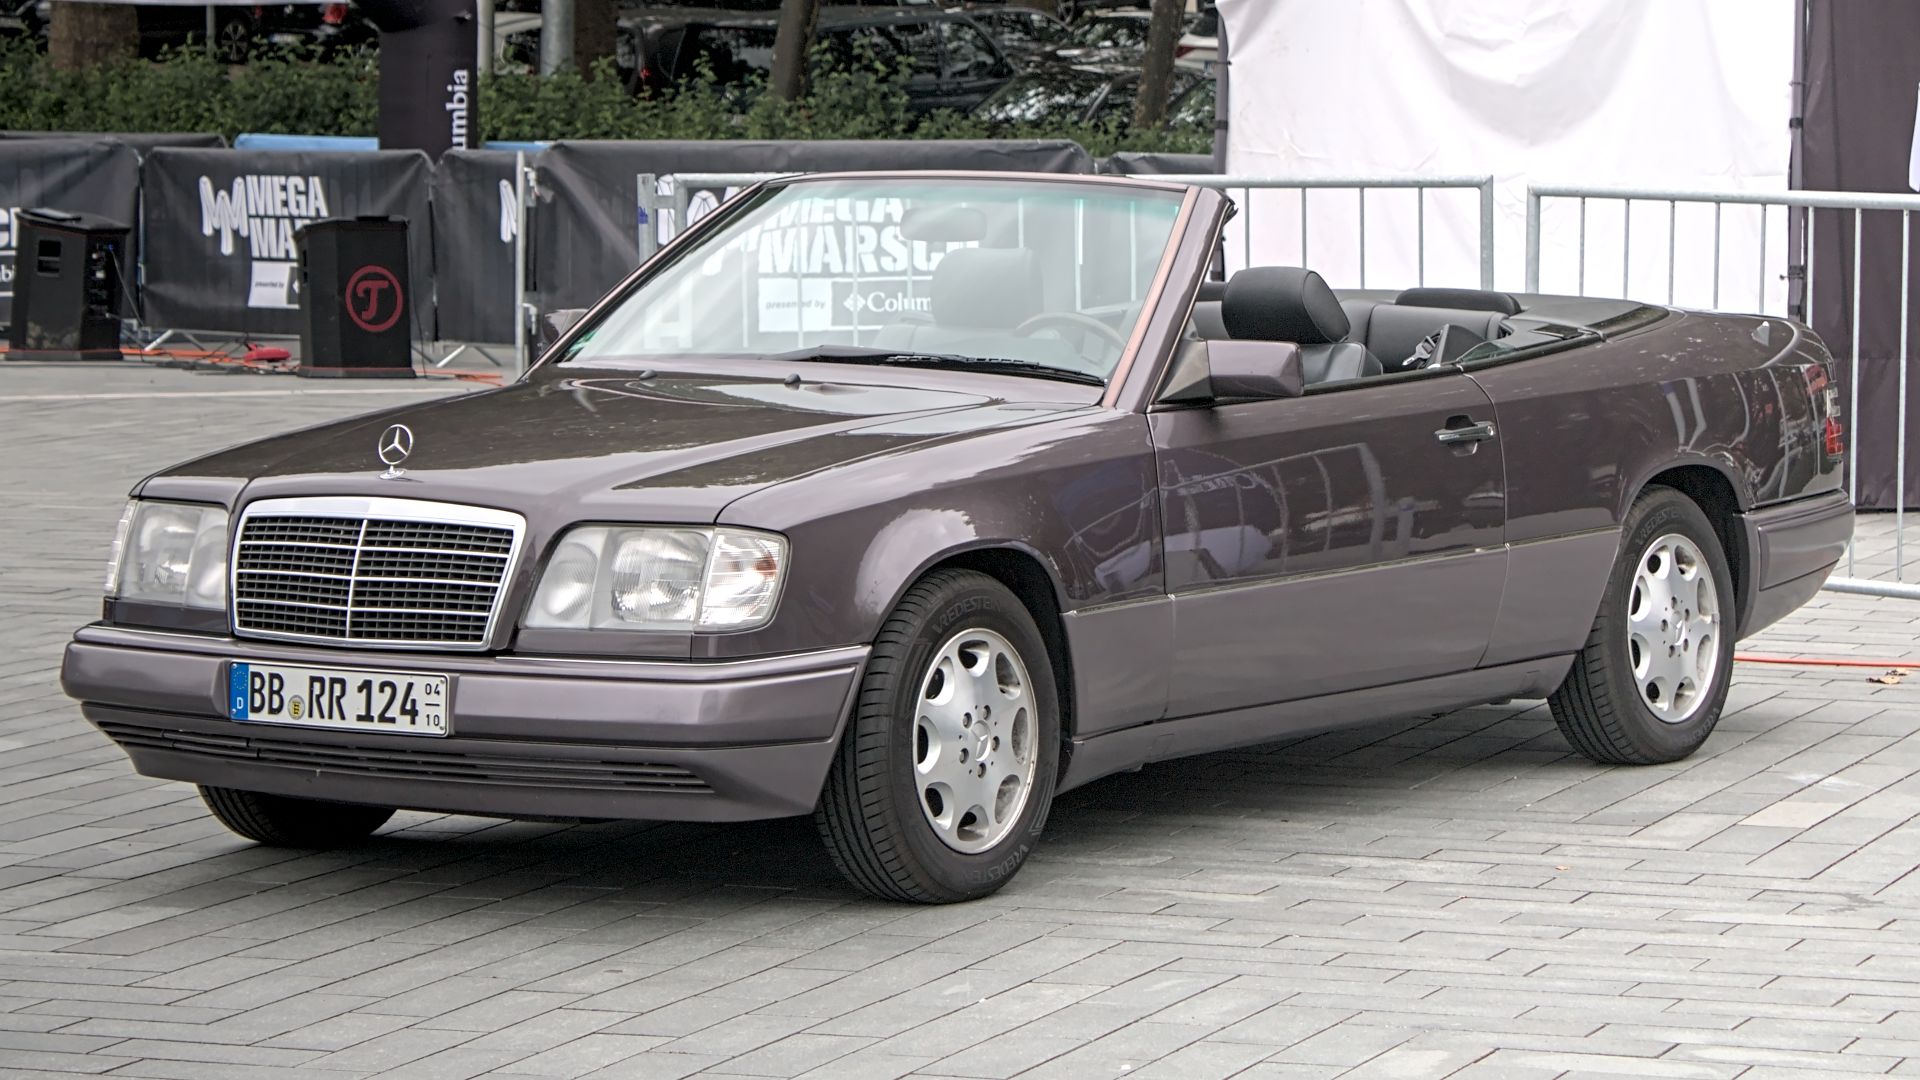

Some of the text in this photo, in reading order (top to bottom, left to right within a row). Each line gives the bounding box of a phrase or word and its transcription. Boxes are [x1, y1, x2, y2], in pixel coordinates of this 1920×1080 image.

[246, 175, 329, 217] MEGA
[757, 225, 978, 273] MARSC
[765, 300, 812, 310] presened
[814, 300, 826, 310] by
[425, 683, 441, 696] 04
[236, 697, 244, 710] D
[249, 670, 419, 726] BB RR 124
[425, 713, 441, 727] 10
